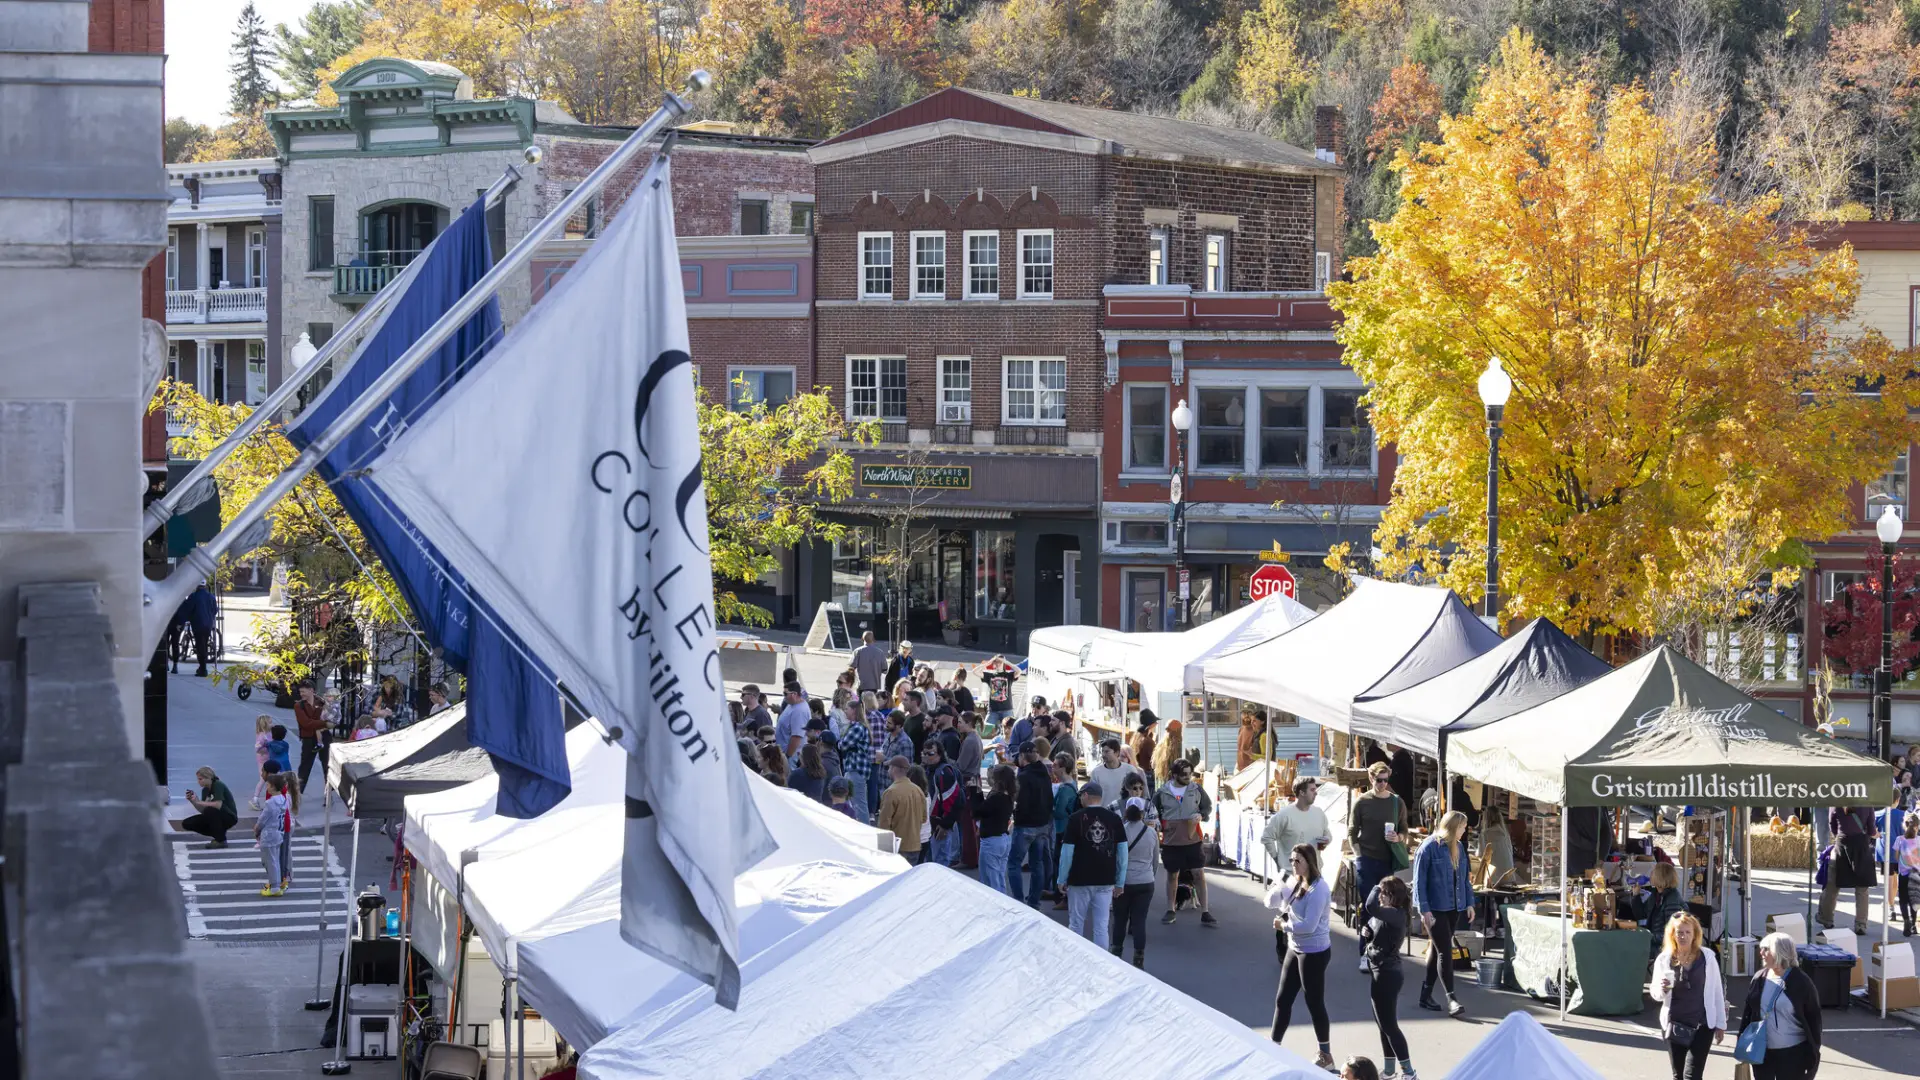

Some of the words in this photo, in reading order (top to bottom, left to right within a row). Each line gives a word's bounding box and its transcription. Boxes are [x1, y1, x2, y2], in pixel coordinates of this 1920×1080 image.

[916, 475, 967, 486] GALLERY
[943, 468, 962, 476] ARTS
[1253, 578, 1292, 596] STOP
[618, 584, 652, 641] by
[1591, 774, 1868, 798] Gristmilldistillers.com
